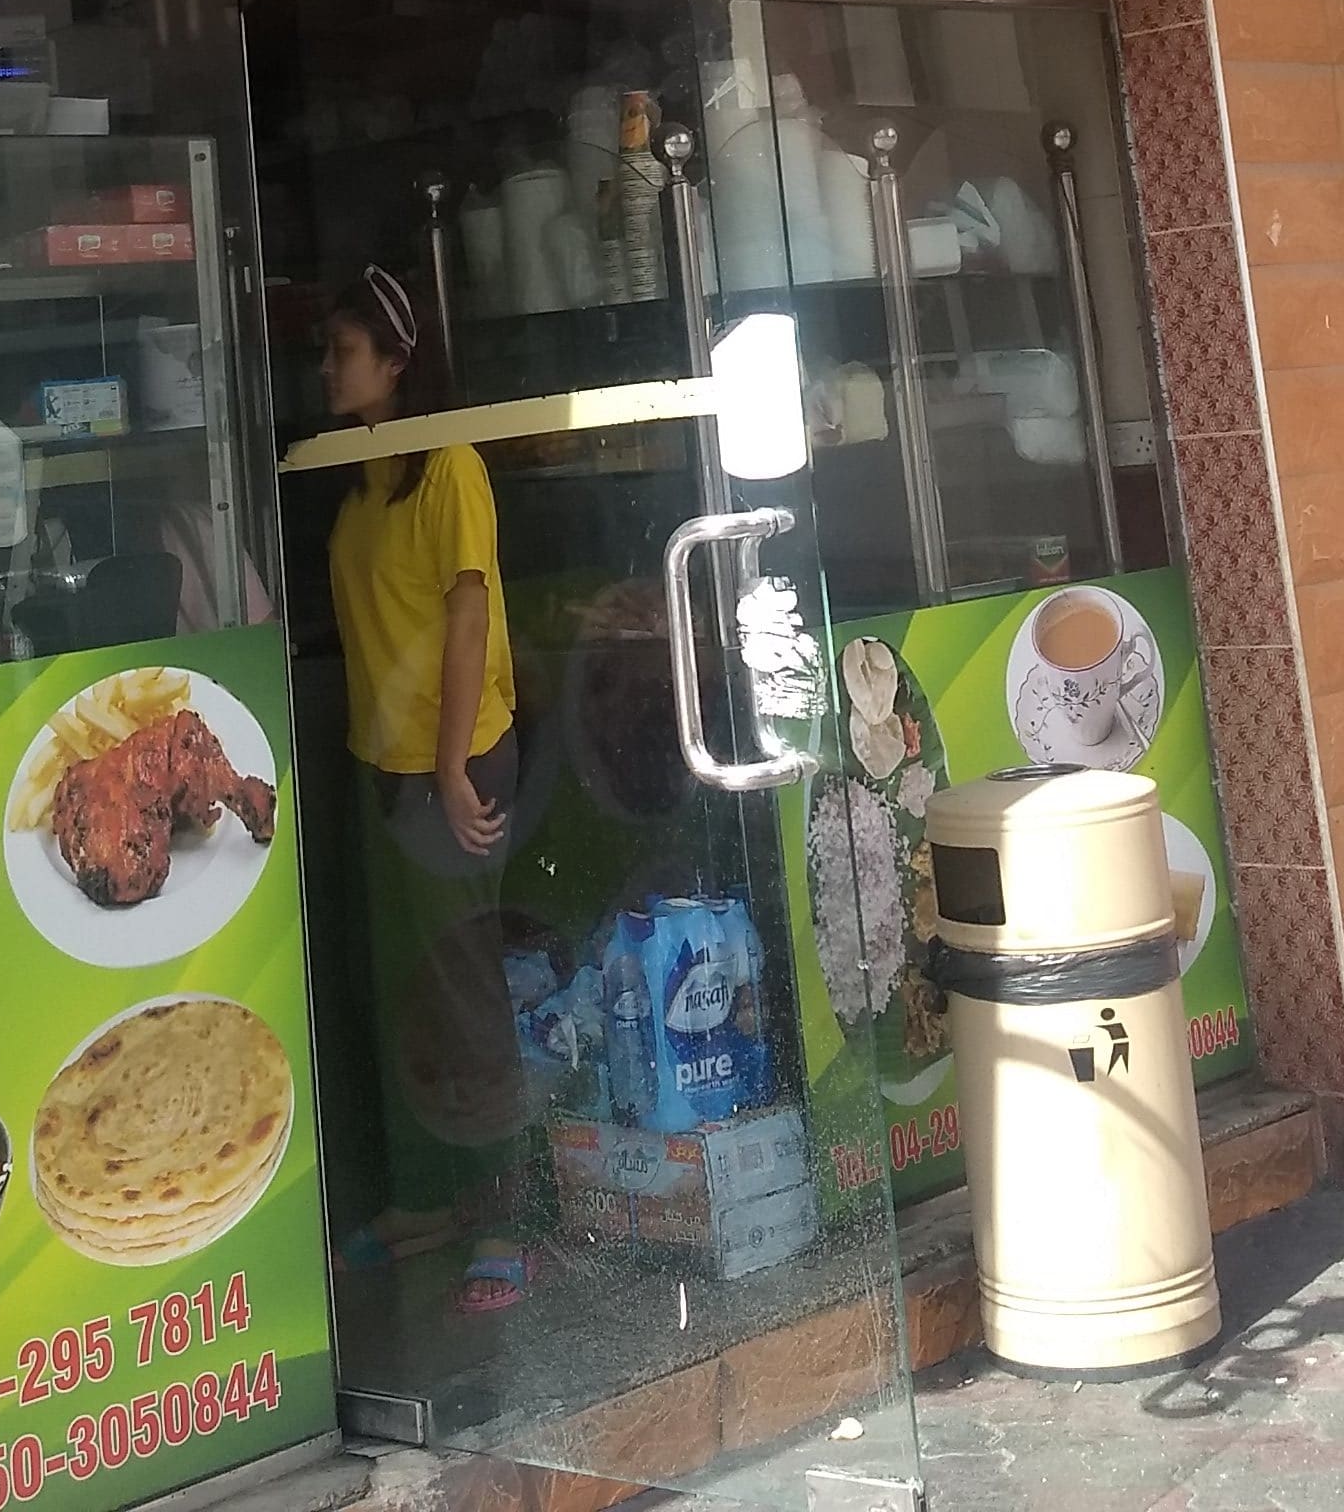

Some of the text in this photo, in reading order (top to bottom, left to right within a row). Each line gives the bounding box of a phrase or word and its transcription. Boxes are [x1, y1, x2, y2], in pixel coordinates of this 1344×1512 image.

[676, 1054, 733, 1091] pure
[890, 1100, 960, 1171] 04-29
[129, 1271, 253, 1366] 7814
